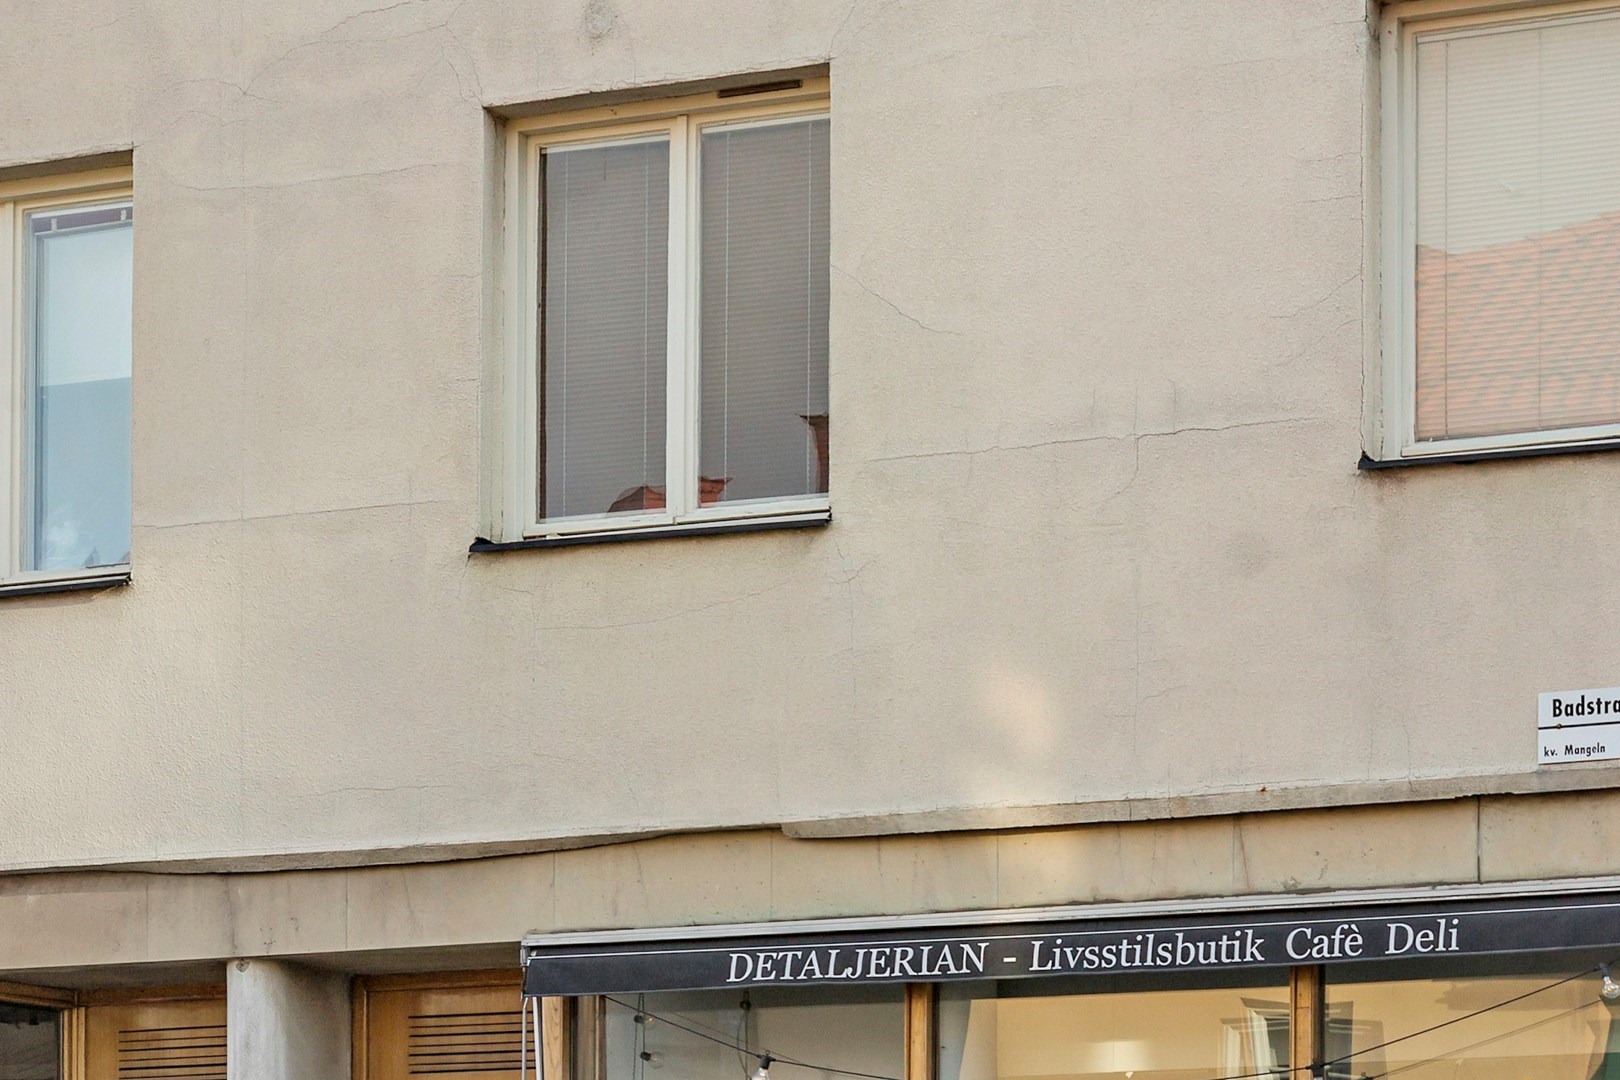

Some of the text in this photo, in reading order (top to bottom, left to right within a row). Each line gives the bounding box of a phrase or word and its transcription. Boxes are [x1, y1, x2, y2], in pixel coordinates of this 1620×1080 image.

[1544, 742, 1606, 757] kv. Mangeln
[726, 942, 989, 982] DETALJERIAN
[1029, 929, 1265, 972] Livsstilsbutik
[1385, 918, 1460, 954] Deli
